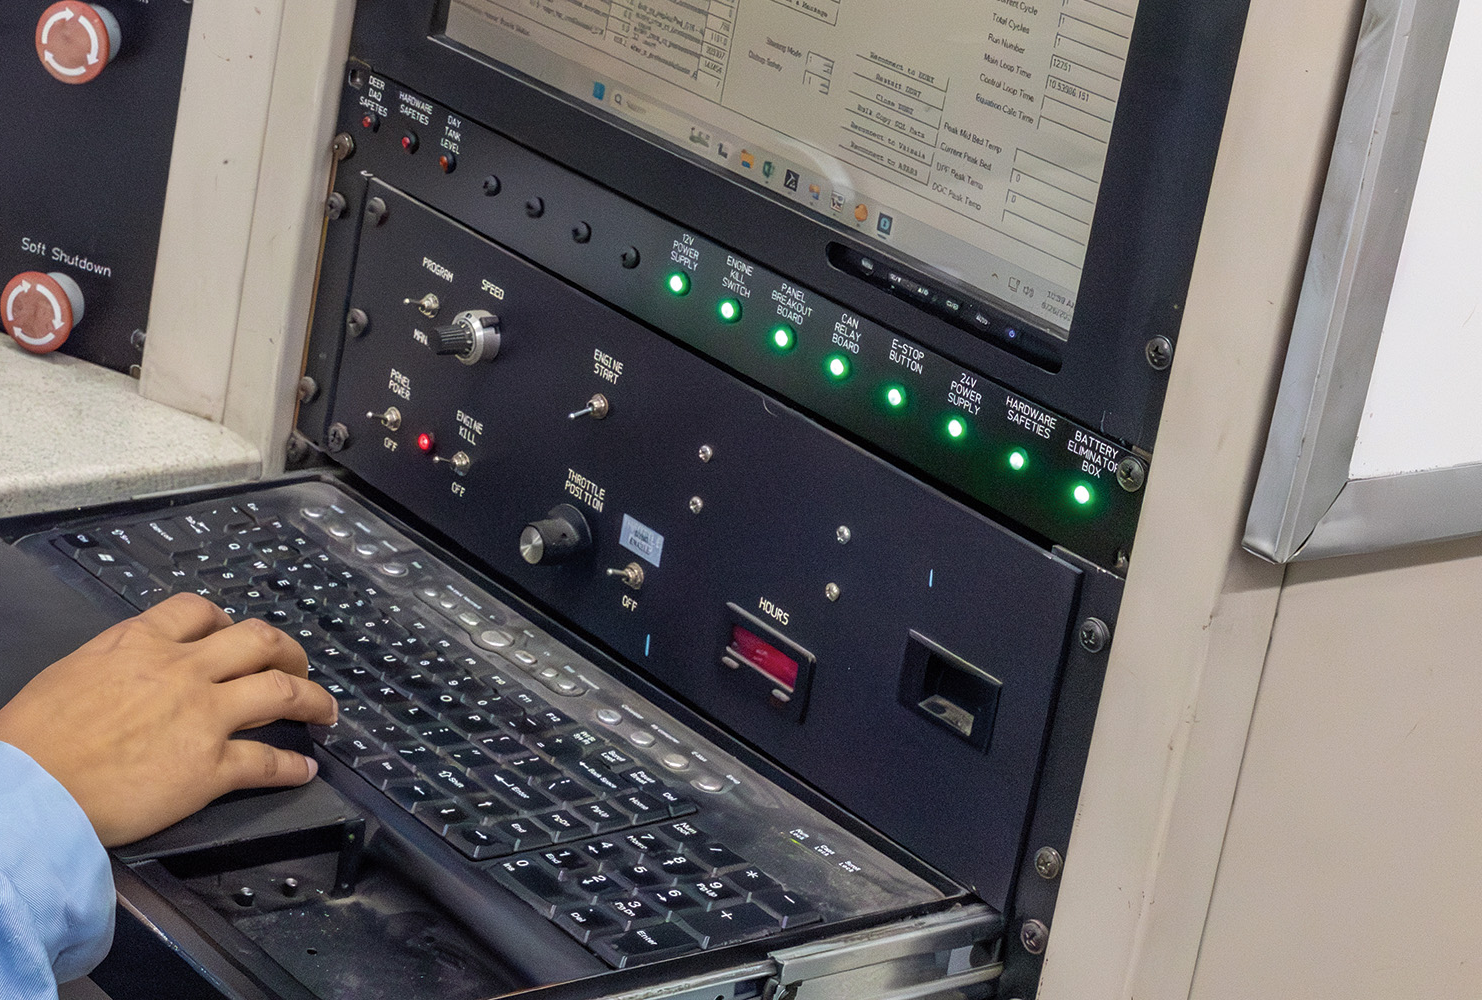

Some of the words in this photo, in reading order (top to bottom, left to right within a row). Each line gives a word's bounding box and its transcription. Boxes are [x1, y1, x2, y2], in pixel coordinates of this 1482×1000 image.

[1019, 1, 1038, 16] Cycle
[399, 91, 433, 115] HARDWARE
[447, 115, 462, 128] DAY
[444, 126, 461, 142] TANK
[440, 138, 460, 155] LEVEL
[682, 233, 695, 246] 12V
[22, 237, 46, 256] Soft
[52, 247, 112, 277] Shutdown
[671, 250, 698, 271] SUPPLY
[673, 240, 699, 261] POWER
[422, 257, 454, 283] PROGRAM
[727, 255, 753, 276] ENGINE
[730, 269, 745, 284] KILL
[481, 279, 504, 300] SPEED
[722, 277, 751, 298] SWITCH
[781, 283, 806, 303] PANEL
[772, 290, 813, 318] BREAKOUT
[777, 305, 803, 326] BOARD
[841, 313, 859, 329] CAN
[835, 322, 862, 342] RELAY
[832, 333, 859, 354] BOARD
[891, 338, 925, 361] E-STOP
[593, 349, 623, 375] ENGINE
[889, 350, 923, 374] BUTTON
[390, 368, 411, 390] PANEL
[594, 362, 619, 385] START
[960, 373, 977, 388] 24V
[389, 379, 411, 400] POWER
[951, 380, 982, 404] POWER
[947, 392, 981, 416] SUPPLY
[1006, 396, 1057, 430] HARDWARE
[456, 410, 483, 435] ENGINE
[1007, 410, 1051, 439] SAFETIES
[458, 426, 477, 446] KILL
[1075, 430, 1119, 459] BATTERY
[1081, 460, 1101, 478] BOX
[567, 468, 606, 500] THROTTLE
[565, 480, 604, 513] POSITION
[622, 595, 638, 612] OFF
[758, 596, 790, 626] HOURS
[325, 648, 339, 656] H
[328, 685, 343, 694] M
[511, 786, 530, 798] Enter
[629, 797, 649, 810] Home
[552, 814, 570, 827] PgDn
[637, 930, 657, 945] Enter
